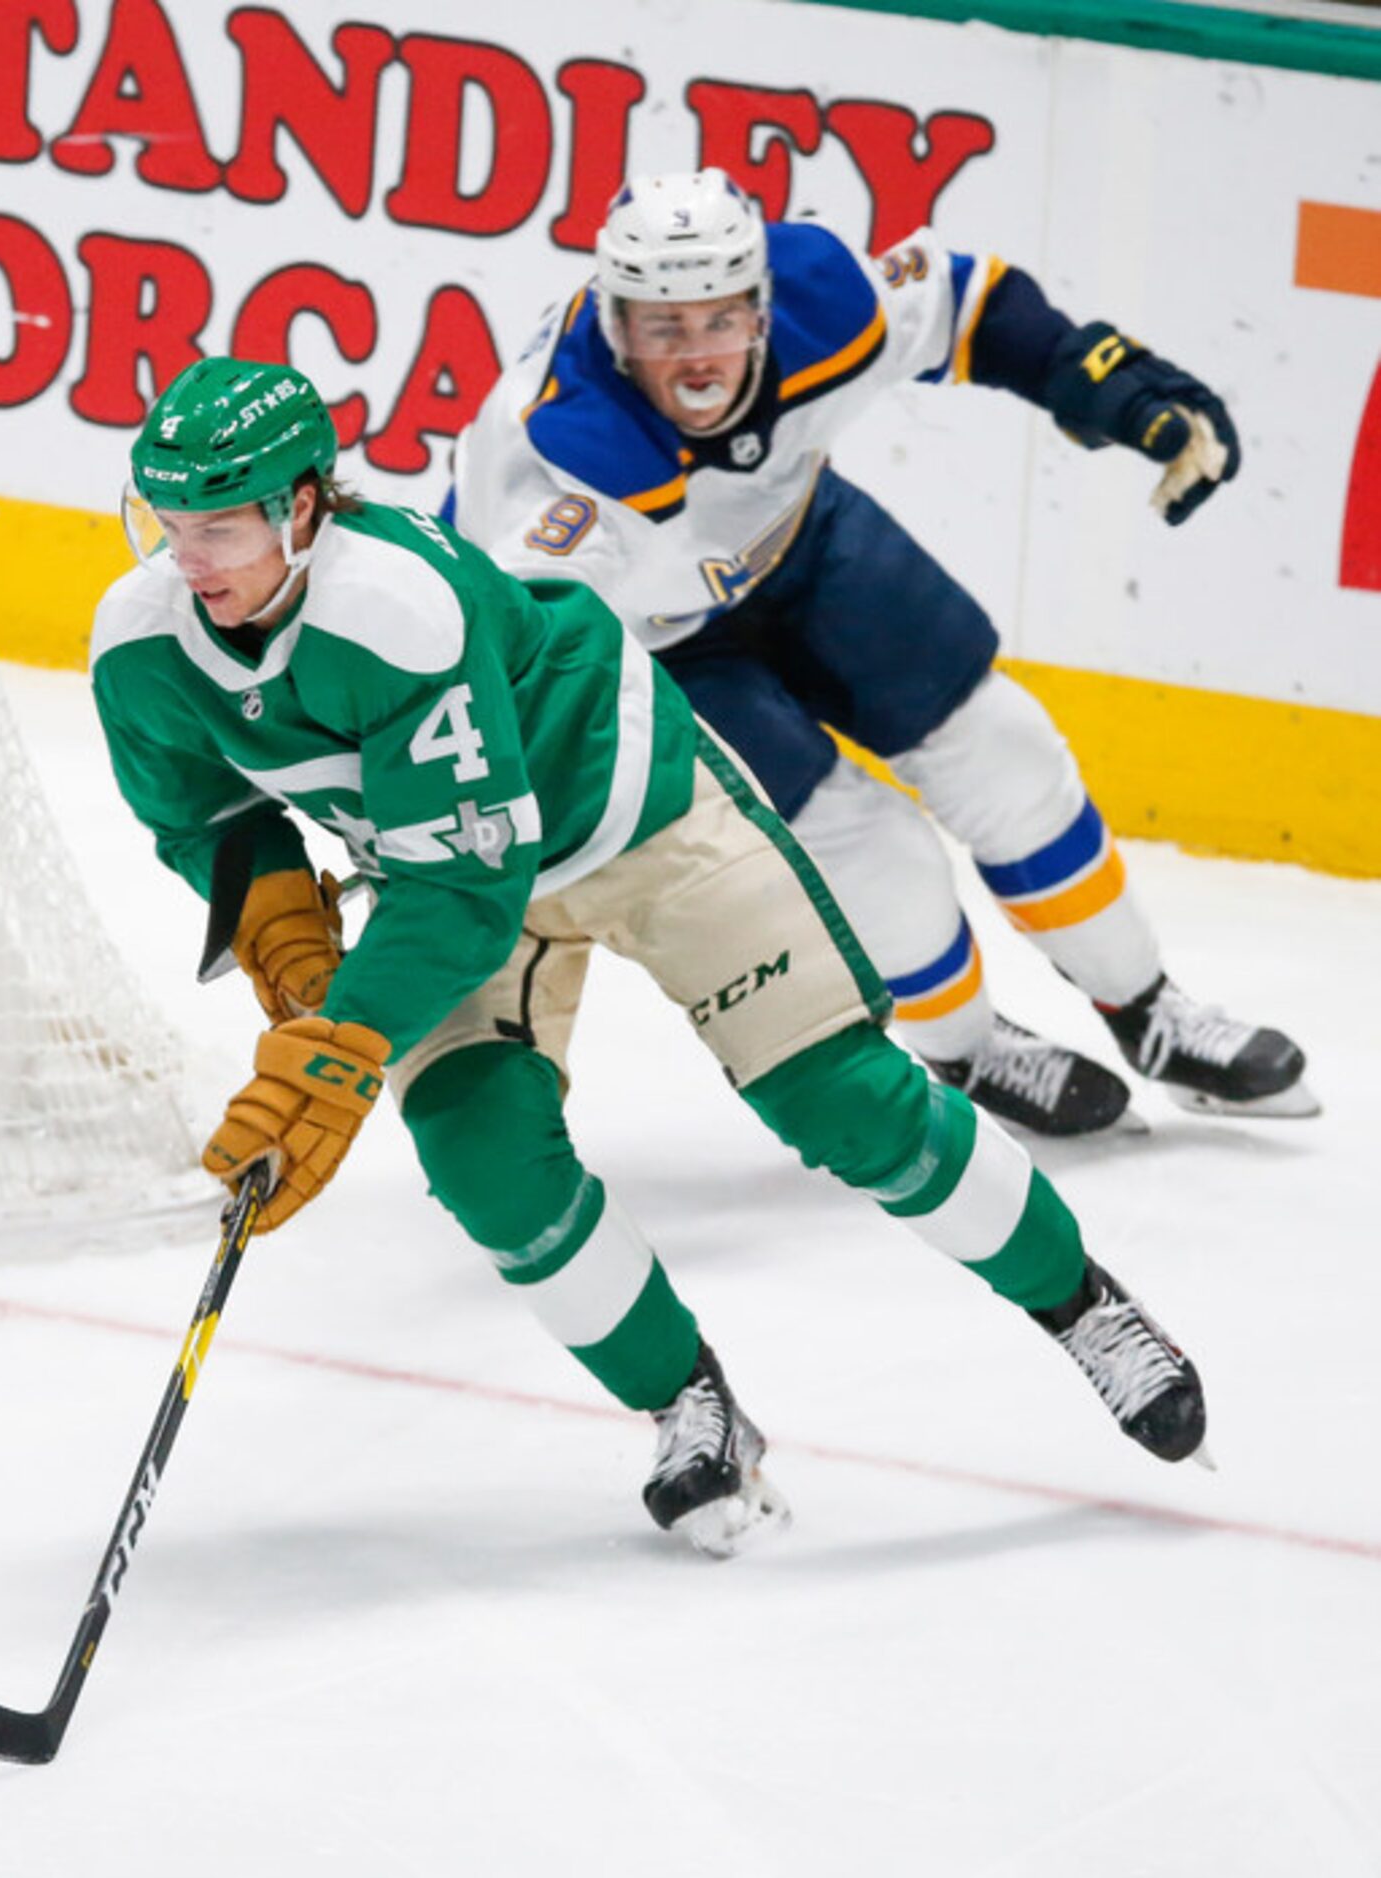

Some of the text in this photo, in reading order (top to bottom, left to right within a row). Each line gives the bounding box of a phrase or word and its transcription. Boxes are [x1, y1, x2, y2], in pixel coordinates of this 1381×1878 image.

[160, 415, 185, 440] 4
[143, 466, 189, 483] CCM
[524, 493, 598, 557] 9
[409, 683, 490, 784] 4
[689, 949, 790, 1026] CCM
